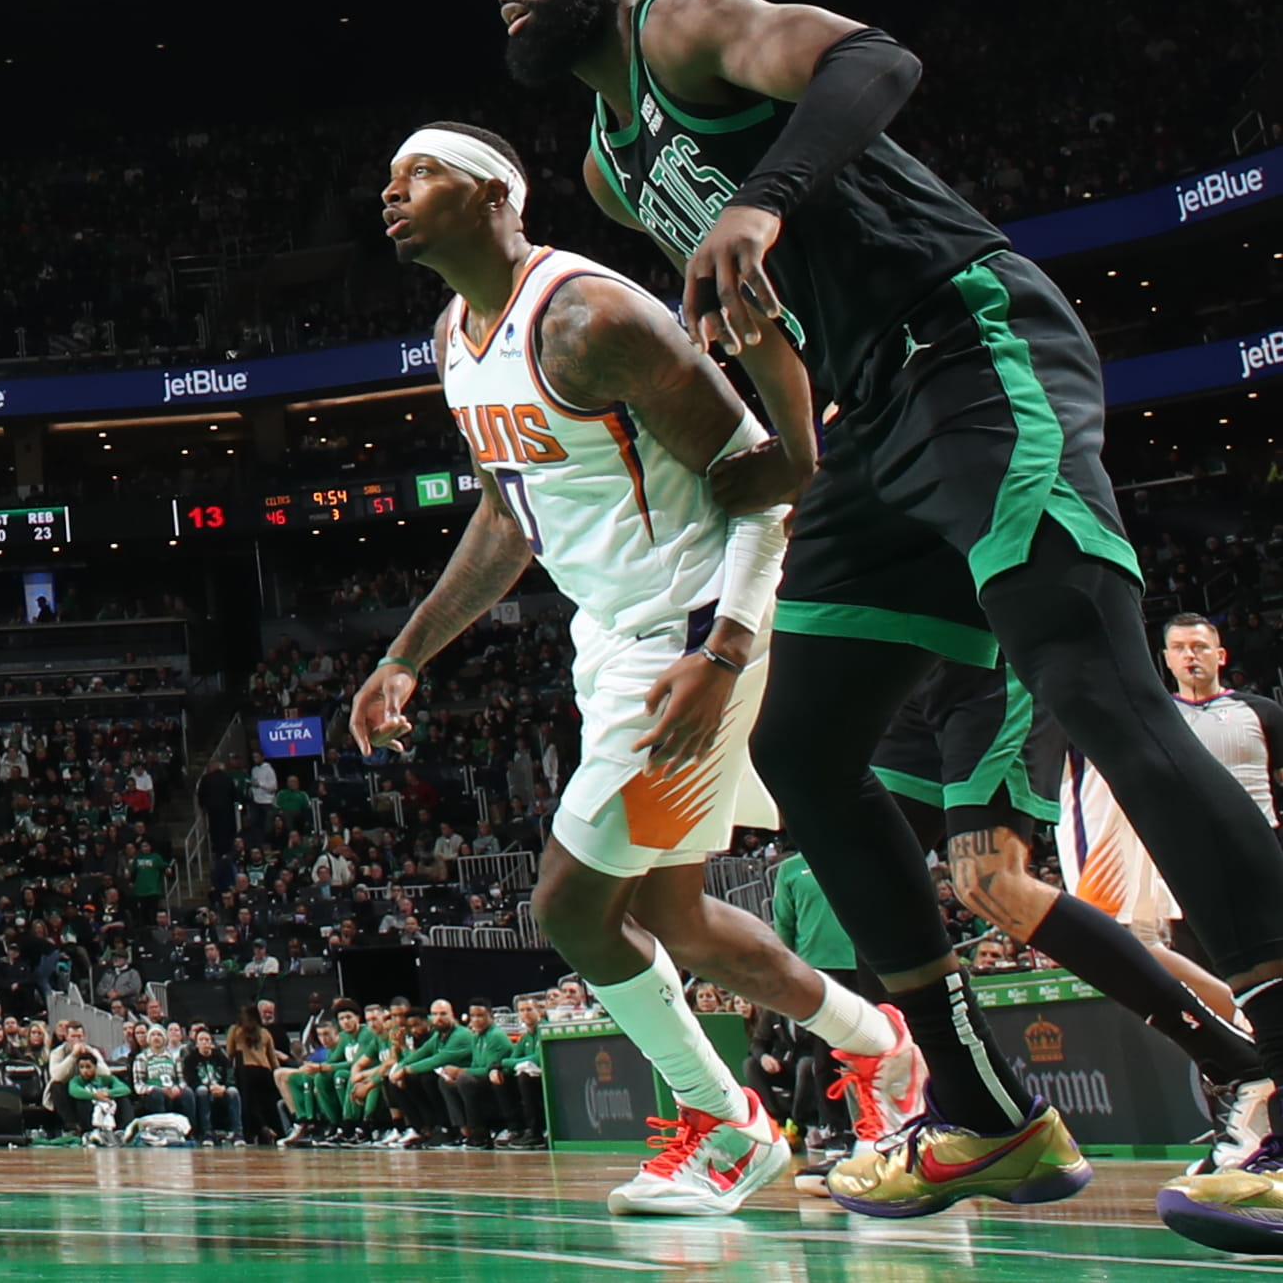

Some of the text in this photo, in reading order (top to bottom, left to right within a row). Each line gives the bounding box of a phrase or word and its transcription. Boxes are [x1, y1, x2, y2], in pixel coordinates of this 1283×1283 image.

[1176, 170, 1263, 222] jetBlue
[499, 349, 523, 358] PayPal
[1239, 331, 1283, 378] jetB
[163, 369, 247, 401] jetBlue
[265, 495, 290, 507] CELTICS
[313, 490, 347, 506] 9:54
[419, 476, 483, 502] TD Ba
[28, 512, 54, 524] REB
[189, 507, 224, 527] 13
[266, 498, 394, 525] 46 57
[34, 527, 51, 540] 23
[269, 727, 312, 741] ULTRA
[584, 1076, 633, 1133] Corona
